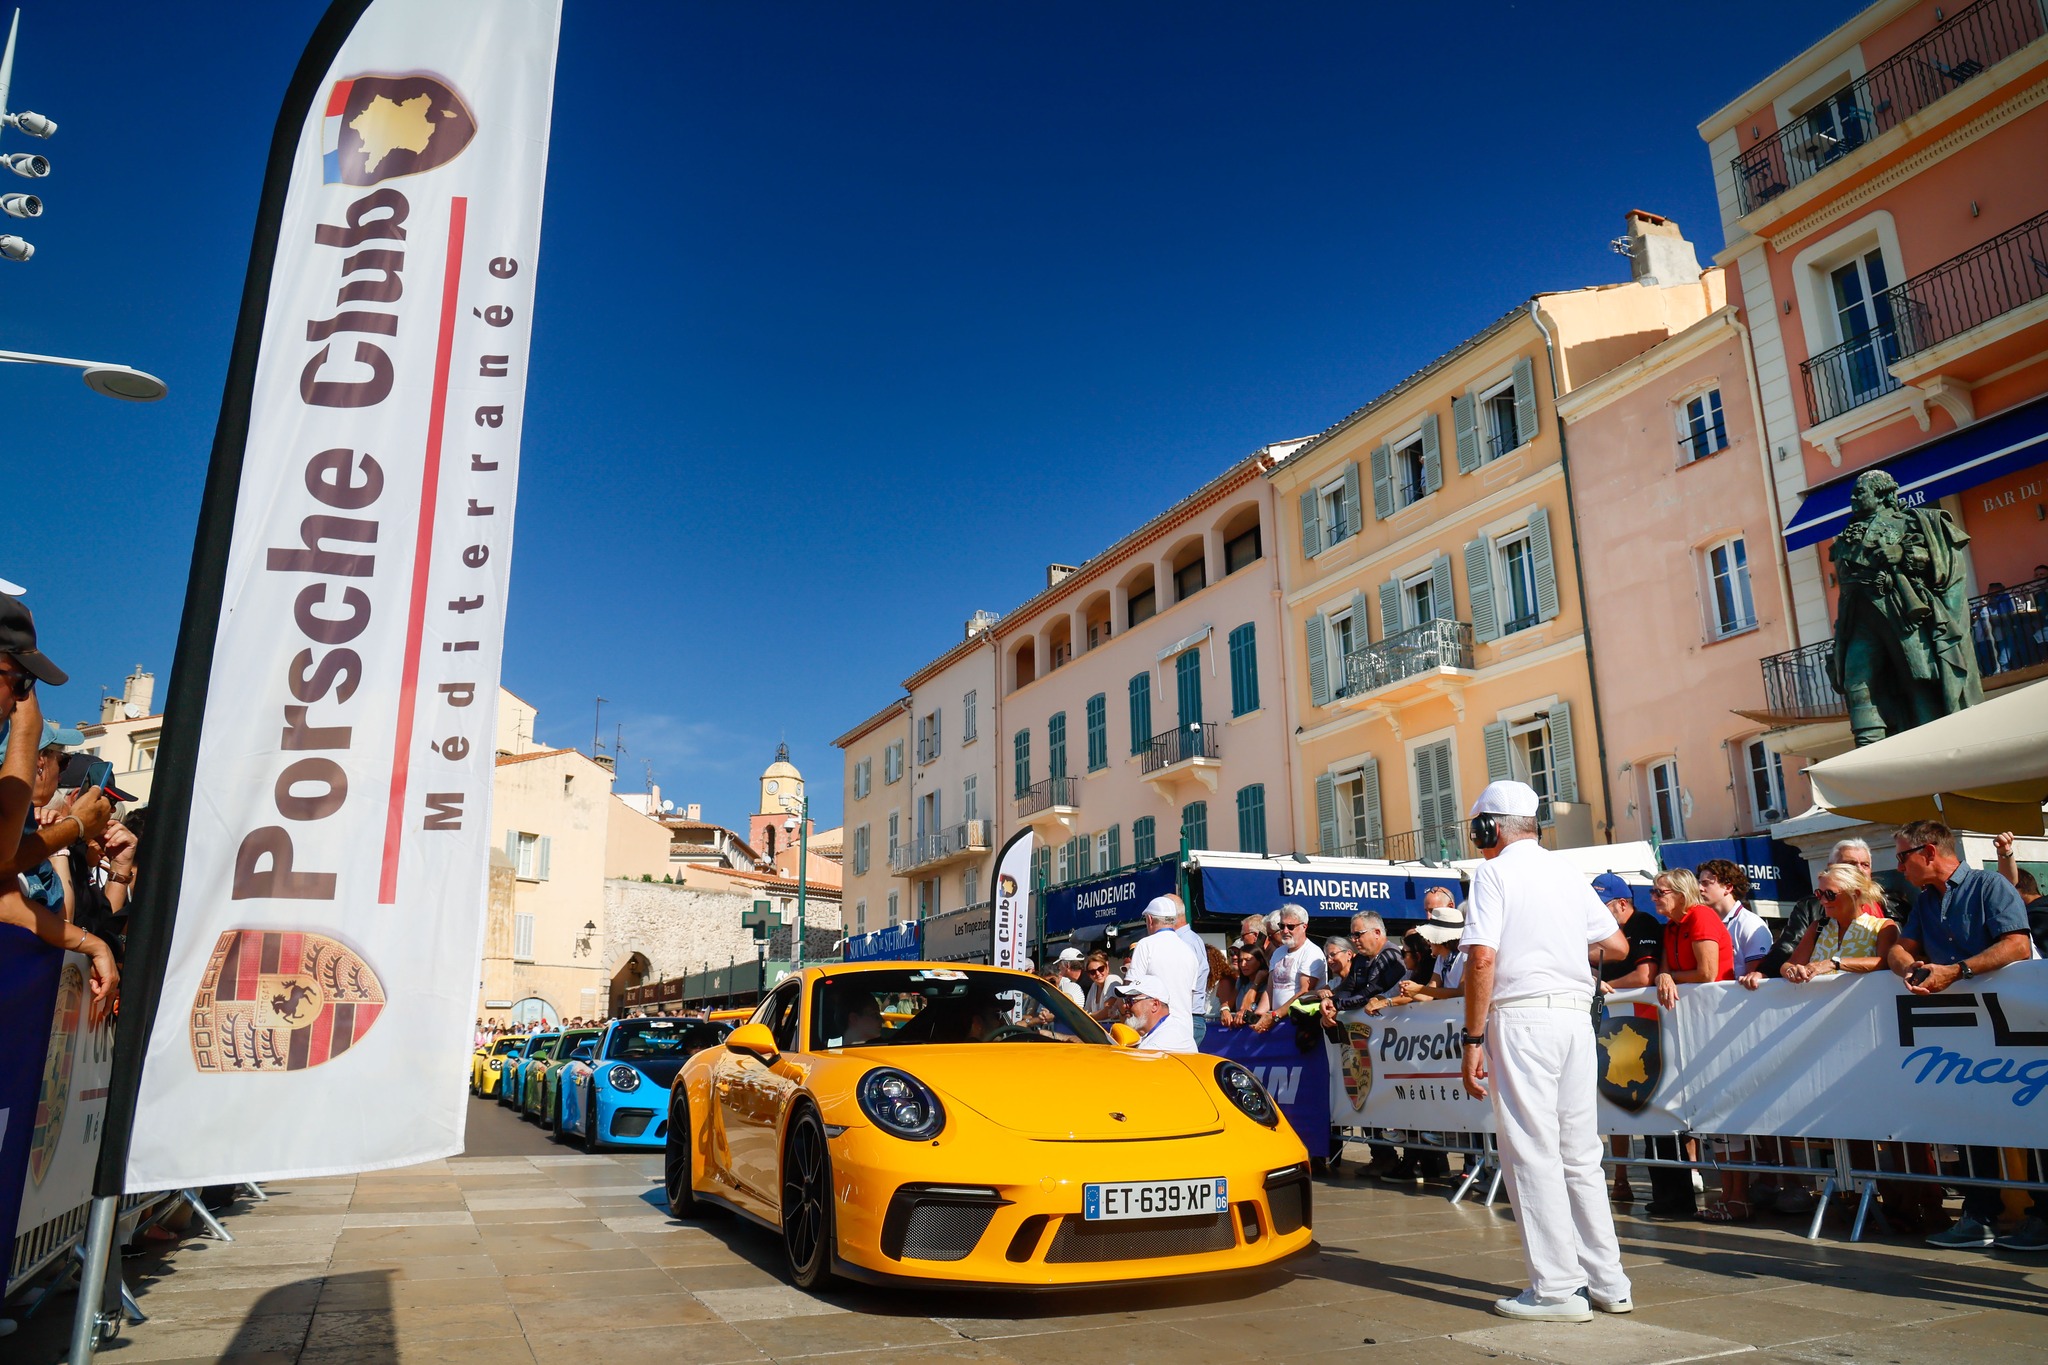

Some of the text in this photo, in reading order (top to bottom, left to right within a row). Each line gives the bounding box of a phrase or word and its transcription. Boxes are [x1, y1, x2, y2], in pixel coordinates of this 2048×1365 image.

[1983, 480, 2042, 512] BAR DU
[231, 187, 410, 901] Porsche Club
[423, 256, 519, 831] Méditerranée
[1077, 882, 1136, 910] BAINDEMER
[1283, 878, 1390, 899] BAINDEMER
[998, 899, 1010, 942] Club
[1319, 901, 1358, 911] ST.TROPEZ
[955, 924, 964, 936] Les
[194, 931, 236, 1068] PORSCHE
[1380, 1023, 1462, 1062] Porsch
[1090, 1184, 1227, 1214] F ET-639-XP 06
